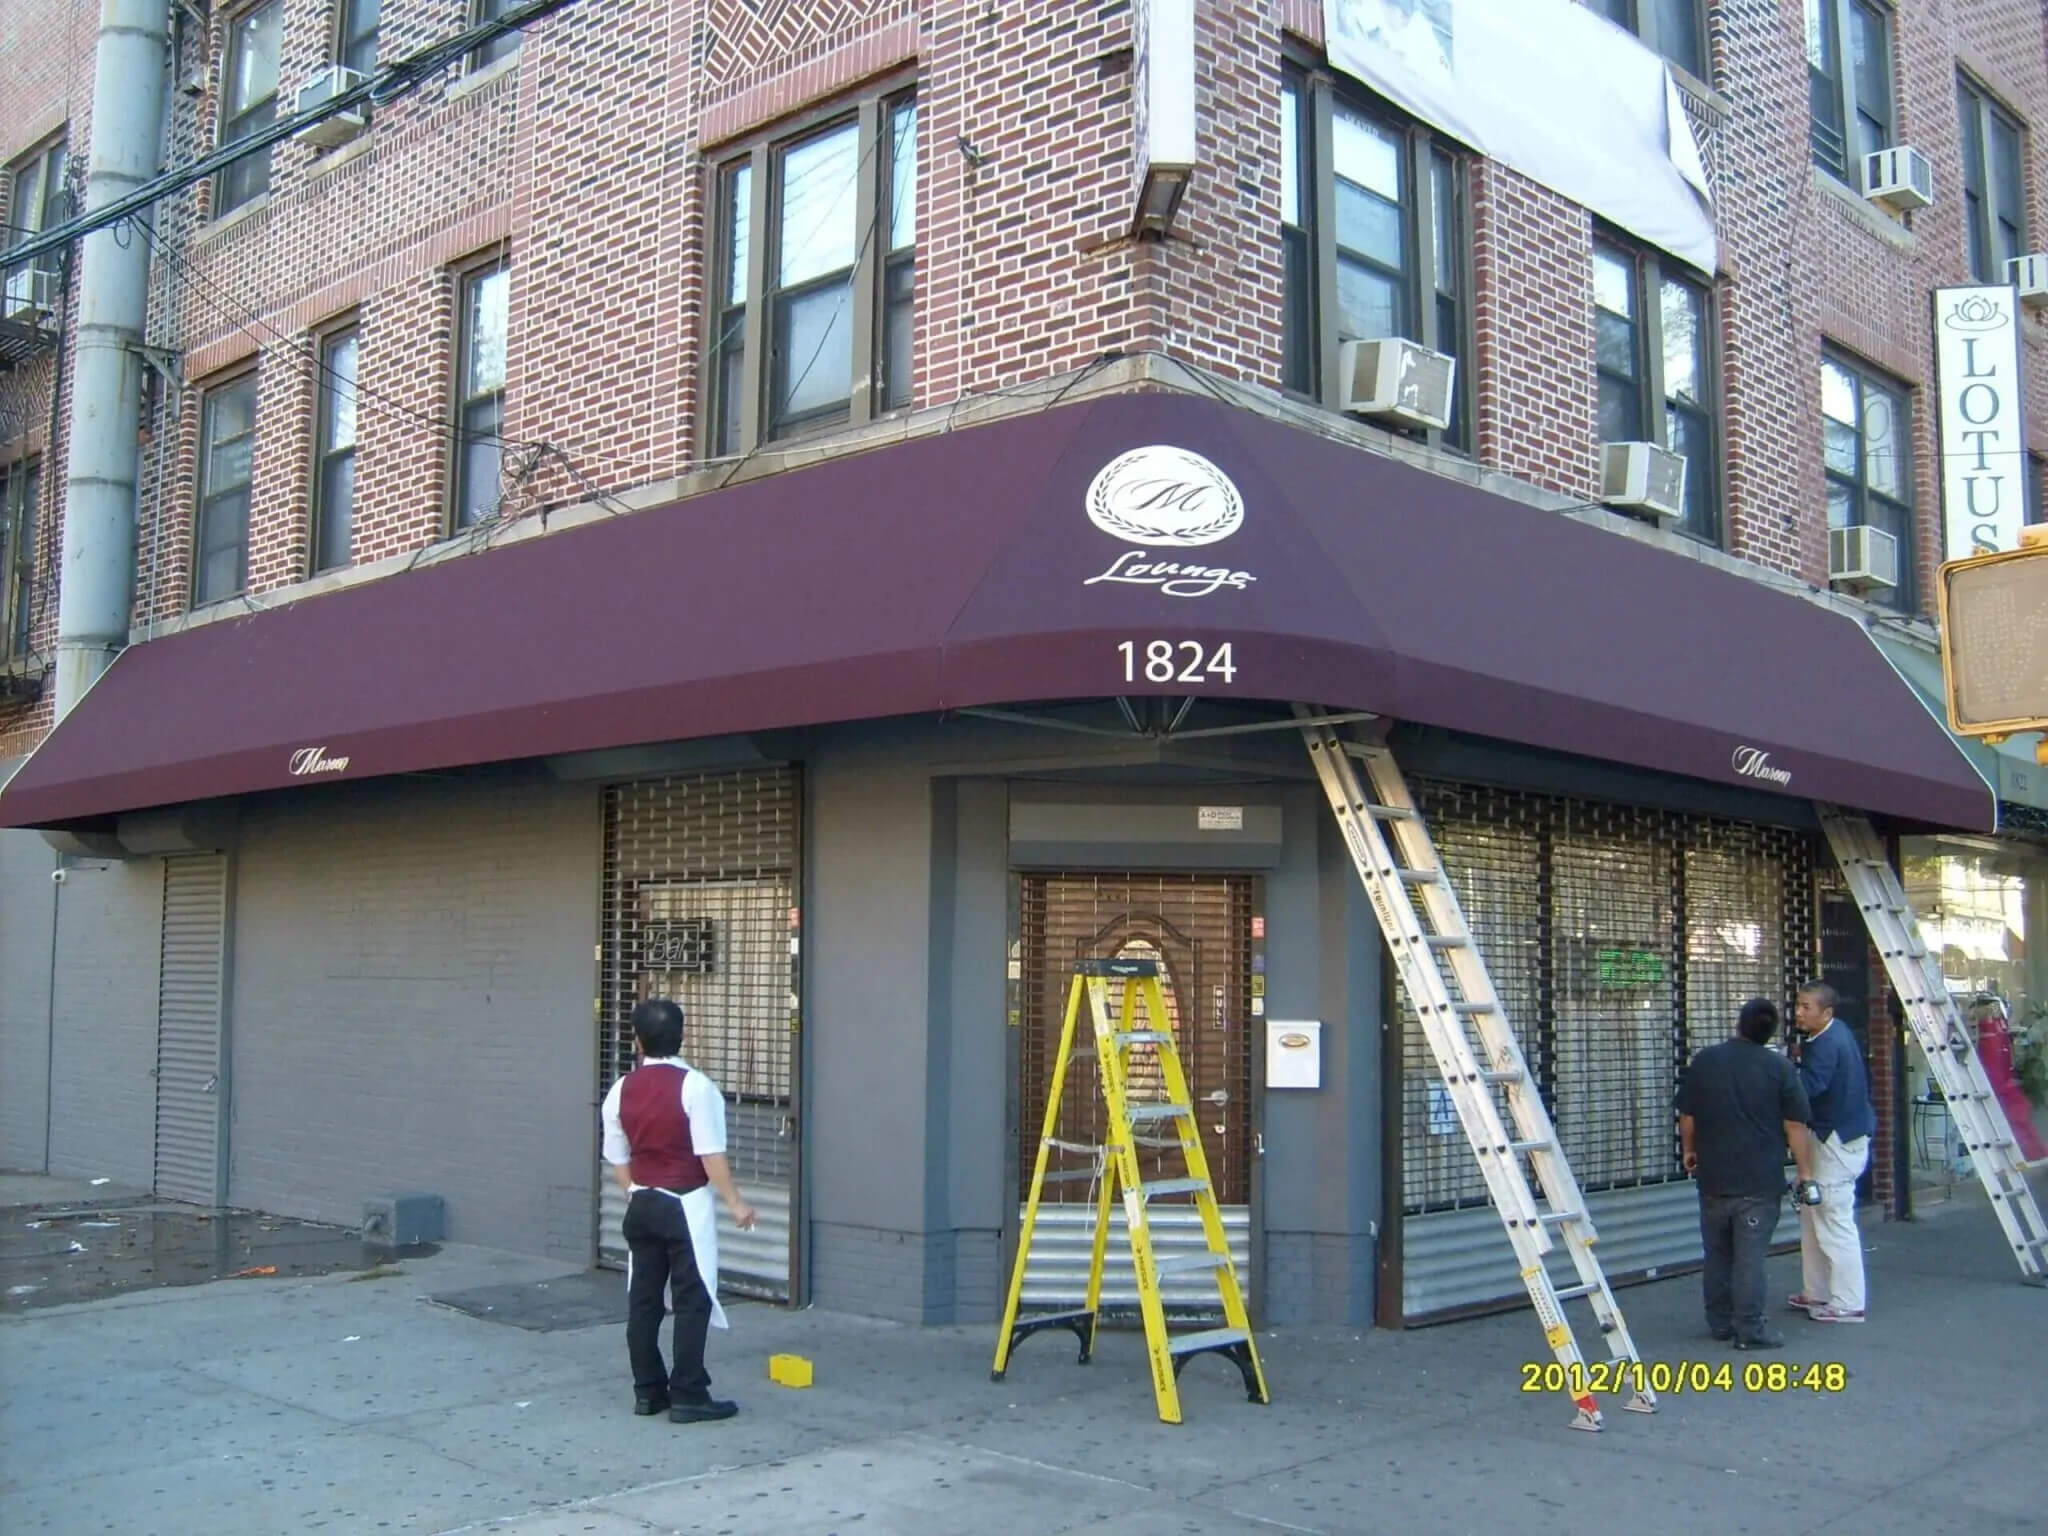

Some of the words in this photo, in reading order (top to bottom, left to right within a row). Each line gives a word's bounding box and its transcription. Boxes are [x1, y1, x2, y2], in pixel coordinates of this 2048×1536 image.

[1959, 338, 2005, 553] LOTUS
[1112, 477, 1213, 512] M
[1083, 550, 1257, 597] Lounge
[1117, 640, 1237, 684] 1824
[651, 930, 695, 961] Bar
[1434, 1089, 1449, 1121] A
